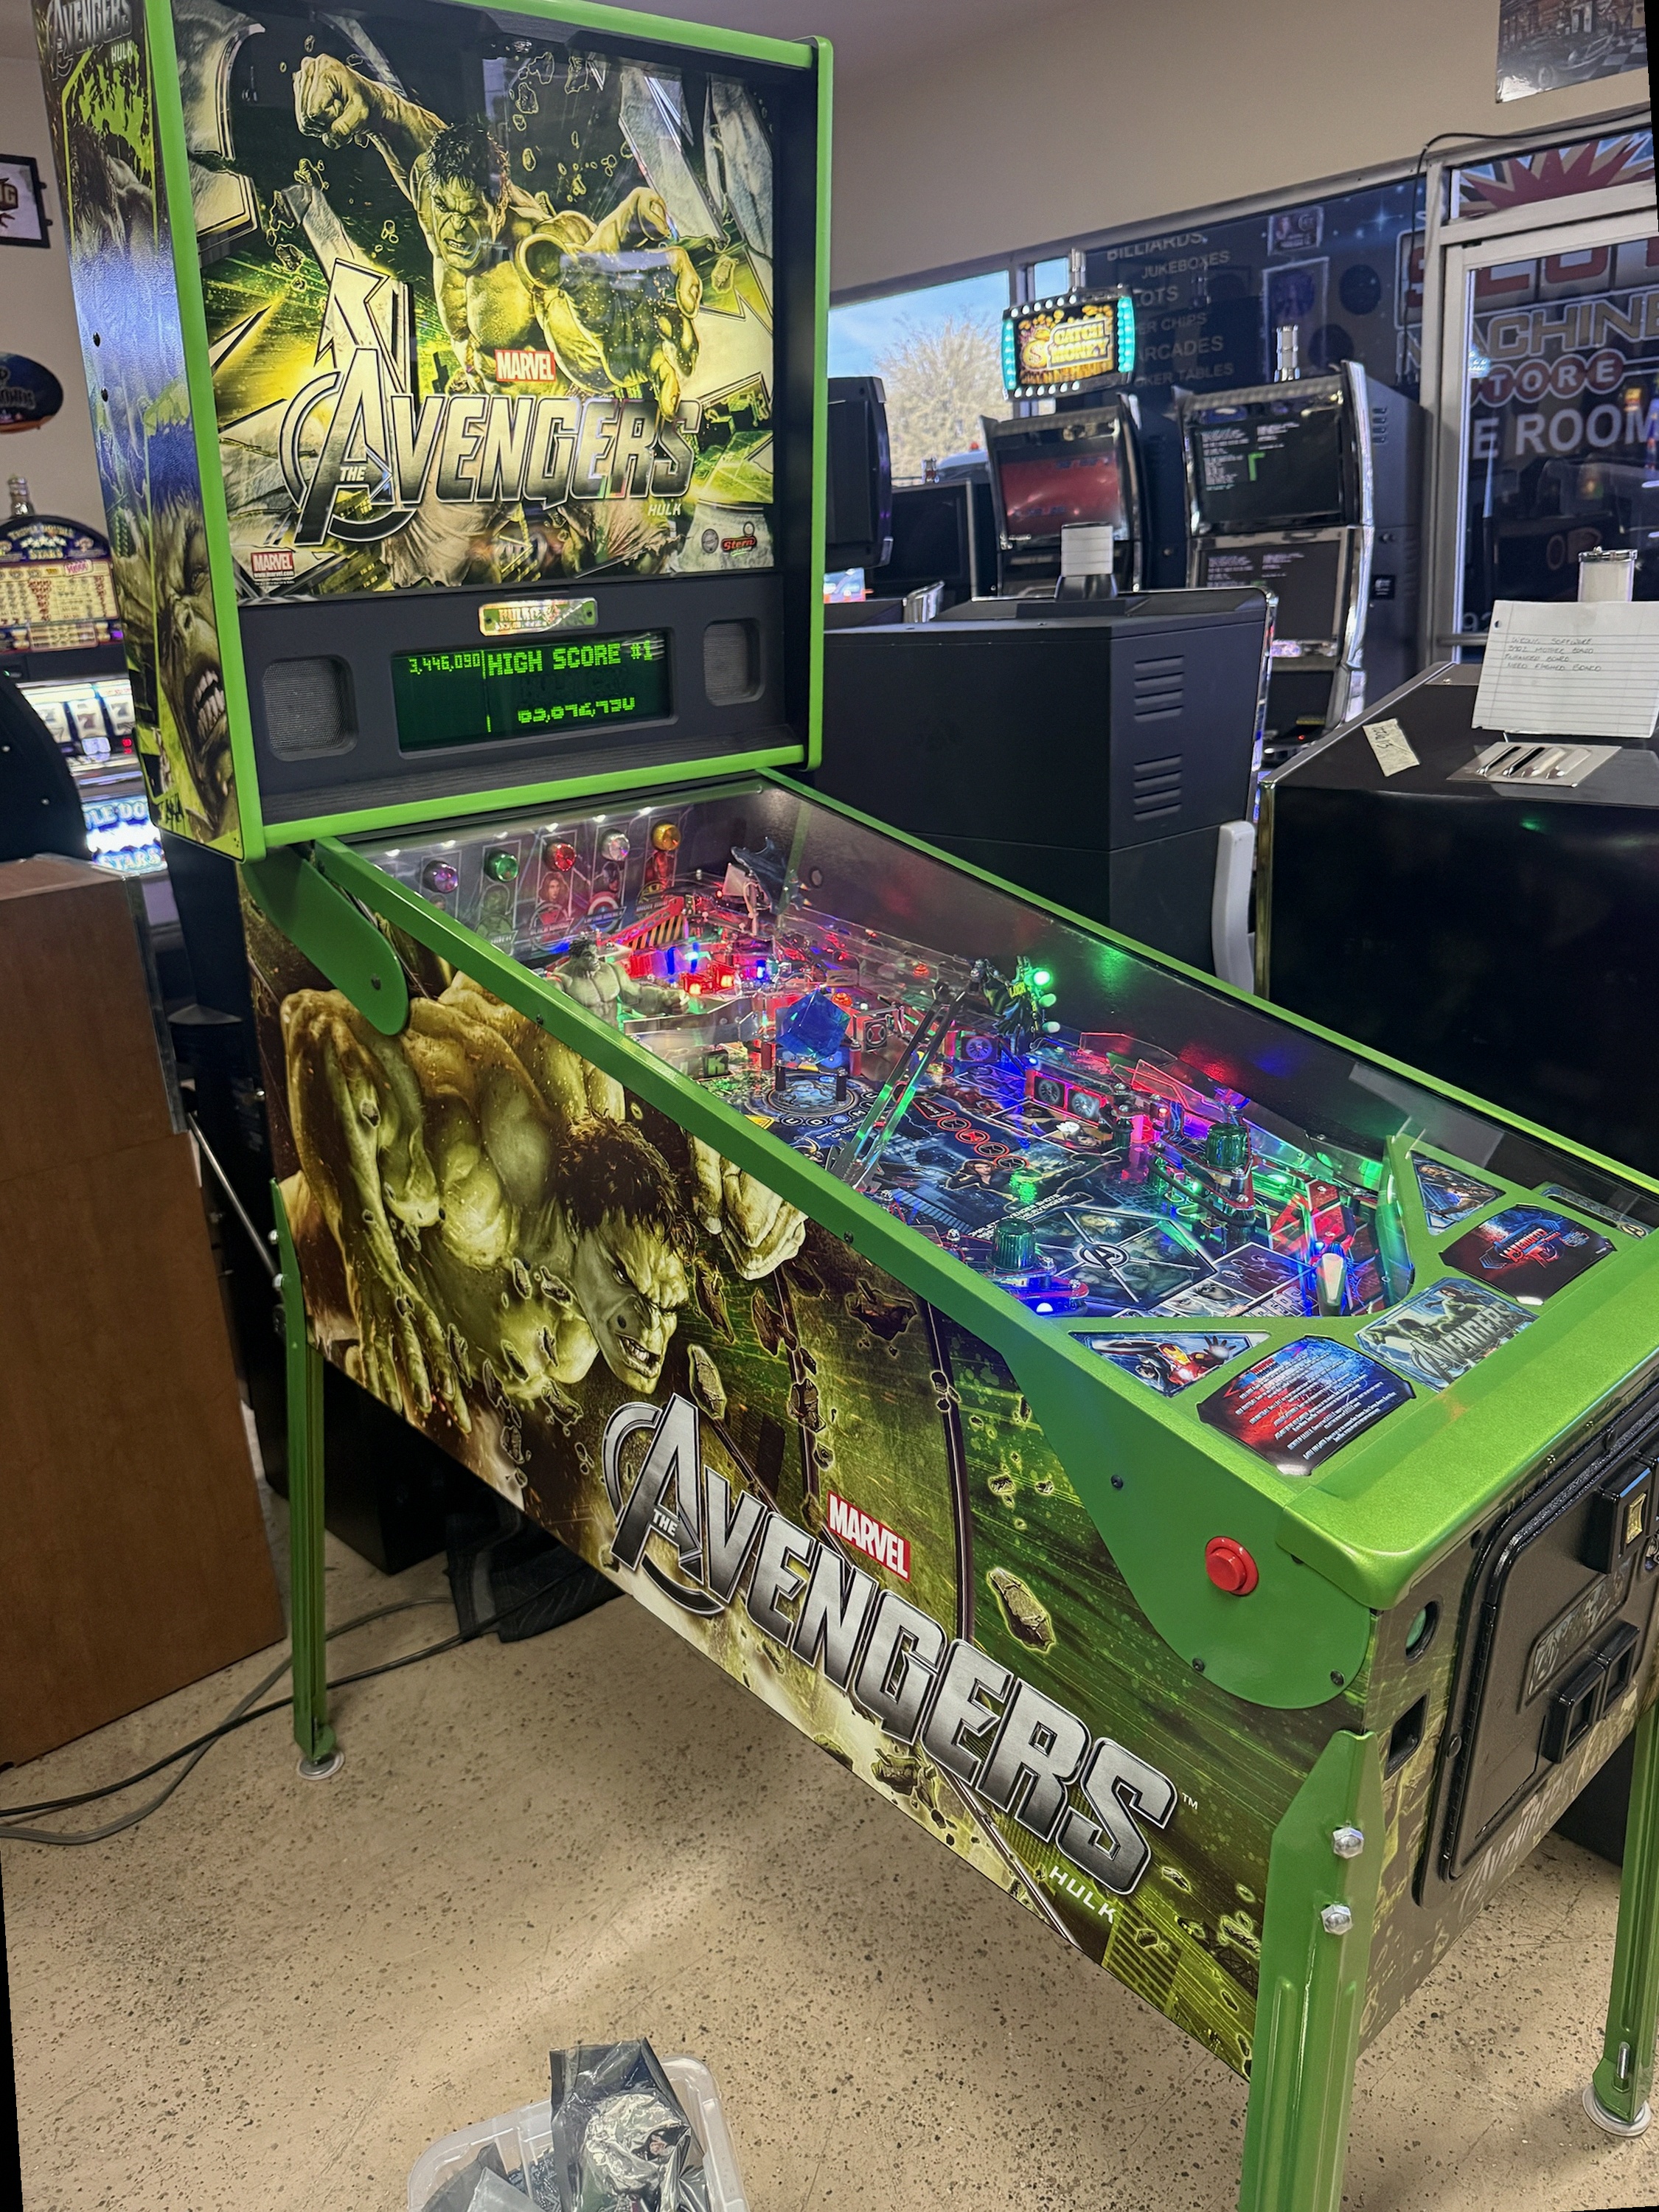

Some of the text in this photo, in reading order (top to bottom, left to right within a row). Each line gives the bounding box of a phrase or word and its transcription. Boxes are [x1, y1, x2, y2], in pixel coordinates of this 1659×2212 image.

[111, 41, 133, 63] HULK
[1141, 251, 1230, 279] JUKEBOXES
[1054, 321, 1105, 345] CATCH
[1160, 312, 1207, 331] CHIPS
[497, 352, 554, 380] MARVEL
[279, 347, 703, 547] AVENGERS
[339, 465, 366, 482] THE
[647, 503, 682, 516] HULK
[723, 539, 755, 552] Stern
[253, 552, 293, 571] MARVEL
[408, 639, 653, 676] 3,446,090 HIGH SCORE #1
[1409, 1300, 1525, 1386] AVENGERS
[652, 1507, 678, 1537] THE
[827, 1492, 911, 1581] MARVEL
[602, 1392, 1178, 1896] AVENGERS
[1048, 1865, 1117, 1923] HULK
